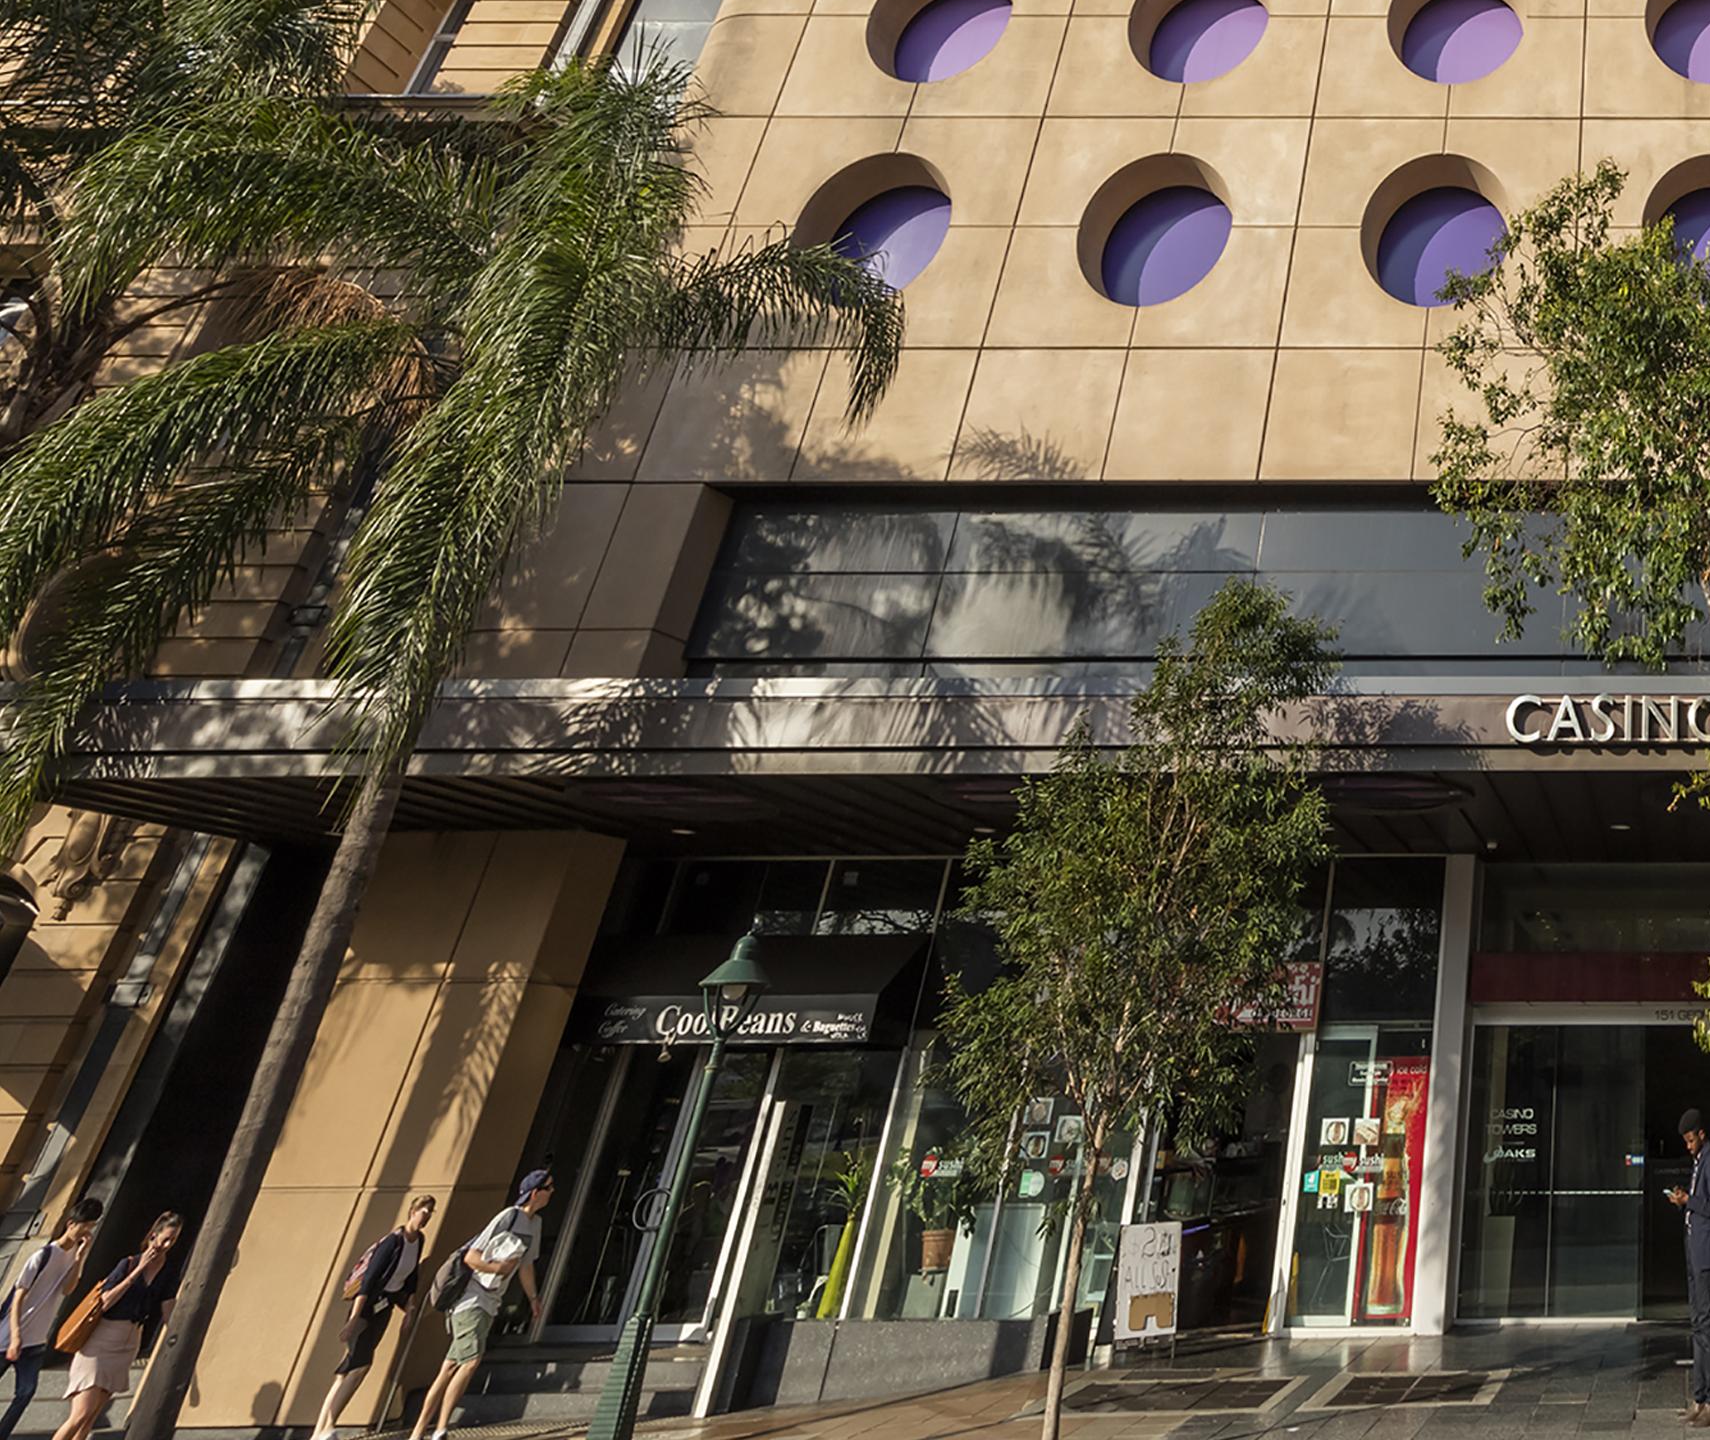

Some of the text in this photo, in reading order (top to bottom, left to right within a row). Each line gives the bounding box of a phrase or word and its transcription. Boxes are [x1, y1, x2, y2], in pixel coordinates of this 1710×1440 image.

[604, 1003, 647, 1021] Catering
[1654, 1010, 1675, 1021] 151
[1489, 1108, 1534, 1120] CASINO
[1487, 1123, 1537, 1135] TOWERS
